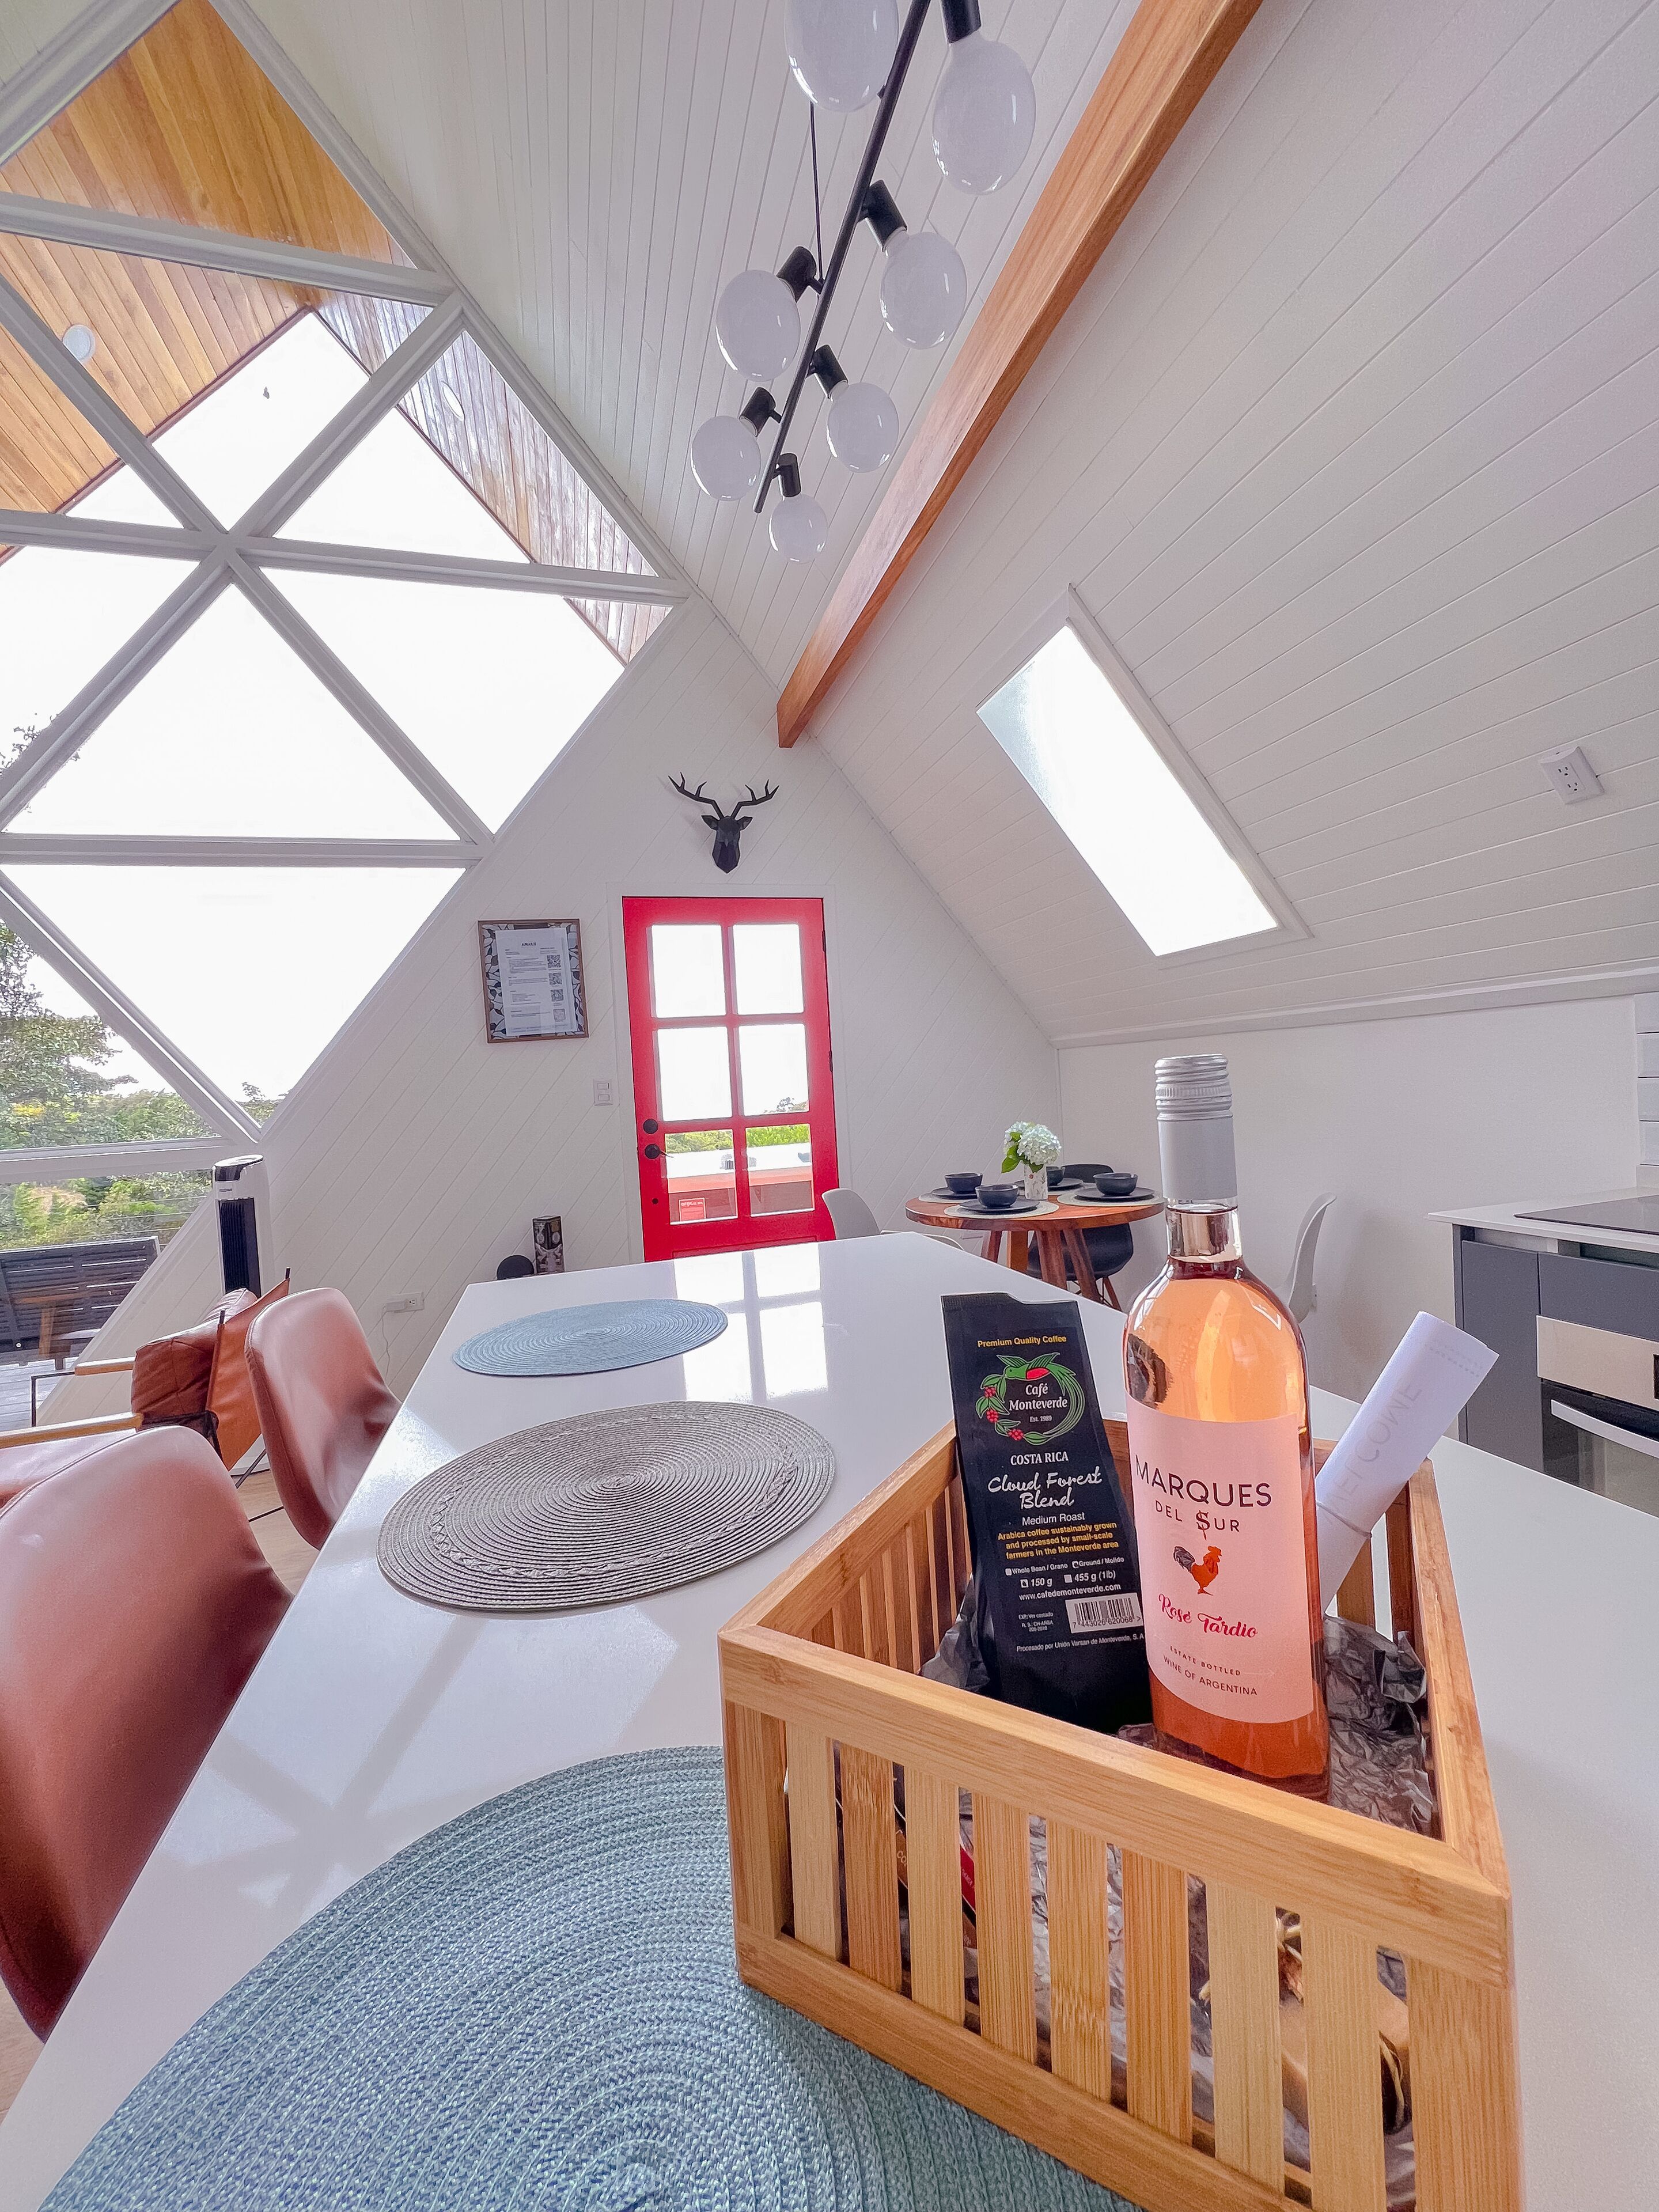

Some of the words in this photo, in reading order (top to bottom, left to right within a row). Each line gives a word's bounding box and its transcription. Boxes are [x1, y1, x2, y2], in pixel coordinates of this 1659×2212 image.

[977, 1339, 1012, 1347] Premium
[1014, 1336, 1041, 1345] Quality
[1042, 1335, 1067, 1343] Coffee
[1025, 1382, 1048, 1397] Café
[1009, 1396, 1068, 1411] Monteverde
[1010, 1453, 1043, 1465] COSTA
[1044, 1451, 1069, 1463] RICA
[988, 1472, 1041, 1493] Cloud
[1046, 1465, 1103, 1488] Forest
[1135, 1454, 1272, 1508] MARQUES
[1019, 1487, 1074, 1509] Blend
[1022, 1516, 1057, 1526] Medium
[1059, 1512, 1085, 1522] Roast
[1155, 1499, 1183, 1522] DEL
[998, 1531, 1025, 1540] Arabica
[1027, 1528, 1050, 1537] coffee
[1051, 1524, 1092, 1535] sustainably
[1094, 1522, 1118, 1532] grown
[1006, 1540, 1020, 1550] and
[1021, 1536, 1059, 1549] processed
[1060, 1535, 1070, 1544] by
[1071, 1531, 1113, 1542] small-scale
[1006, 1549, 1035, 1559] farmers
[1036, 1548, 1043, 1556] in
[1044, 1547, 1057, 1555] the
[1058, 1542, 1101, 1554] Monteverde
[1103, 1541, 1119, 1549] area
[1078, 1559, 1101, 1567] Ground
[1030, 1577, 1045, 1587] 150
[1047, 1578, 1053, 1587] g
[1074, 1573, 1089, 1582] 455
[1090, 1573, 1097, 1582] g
[1099, 1570, 1116, 1581] (1lb)
[1019, 1584, 1122, 1601] www.cafedemonteverde.com
[1016, 1643, 1044, 1652] Procesado
[1044, 1643, 1054, 1651] por
[1054, 1641, 1070, 1649] Unión
[1170, 1645, 1196, 1664] ESTATE
[1201, 1661, 1241, 1676] BOTTLED
[1163, 1654, 1182, 1674] WINE
[1184, 1669, 1196, 1680] OF
[1199, 1677, 1257, 1695] ARGENTINA
